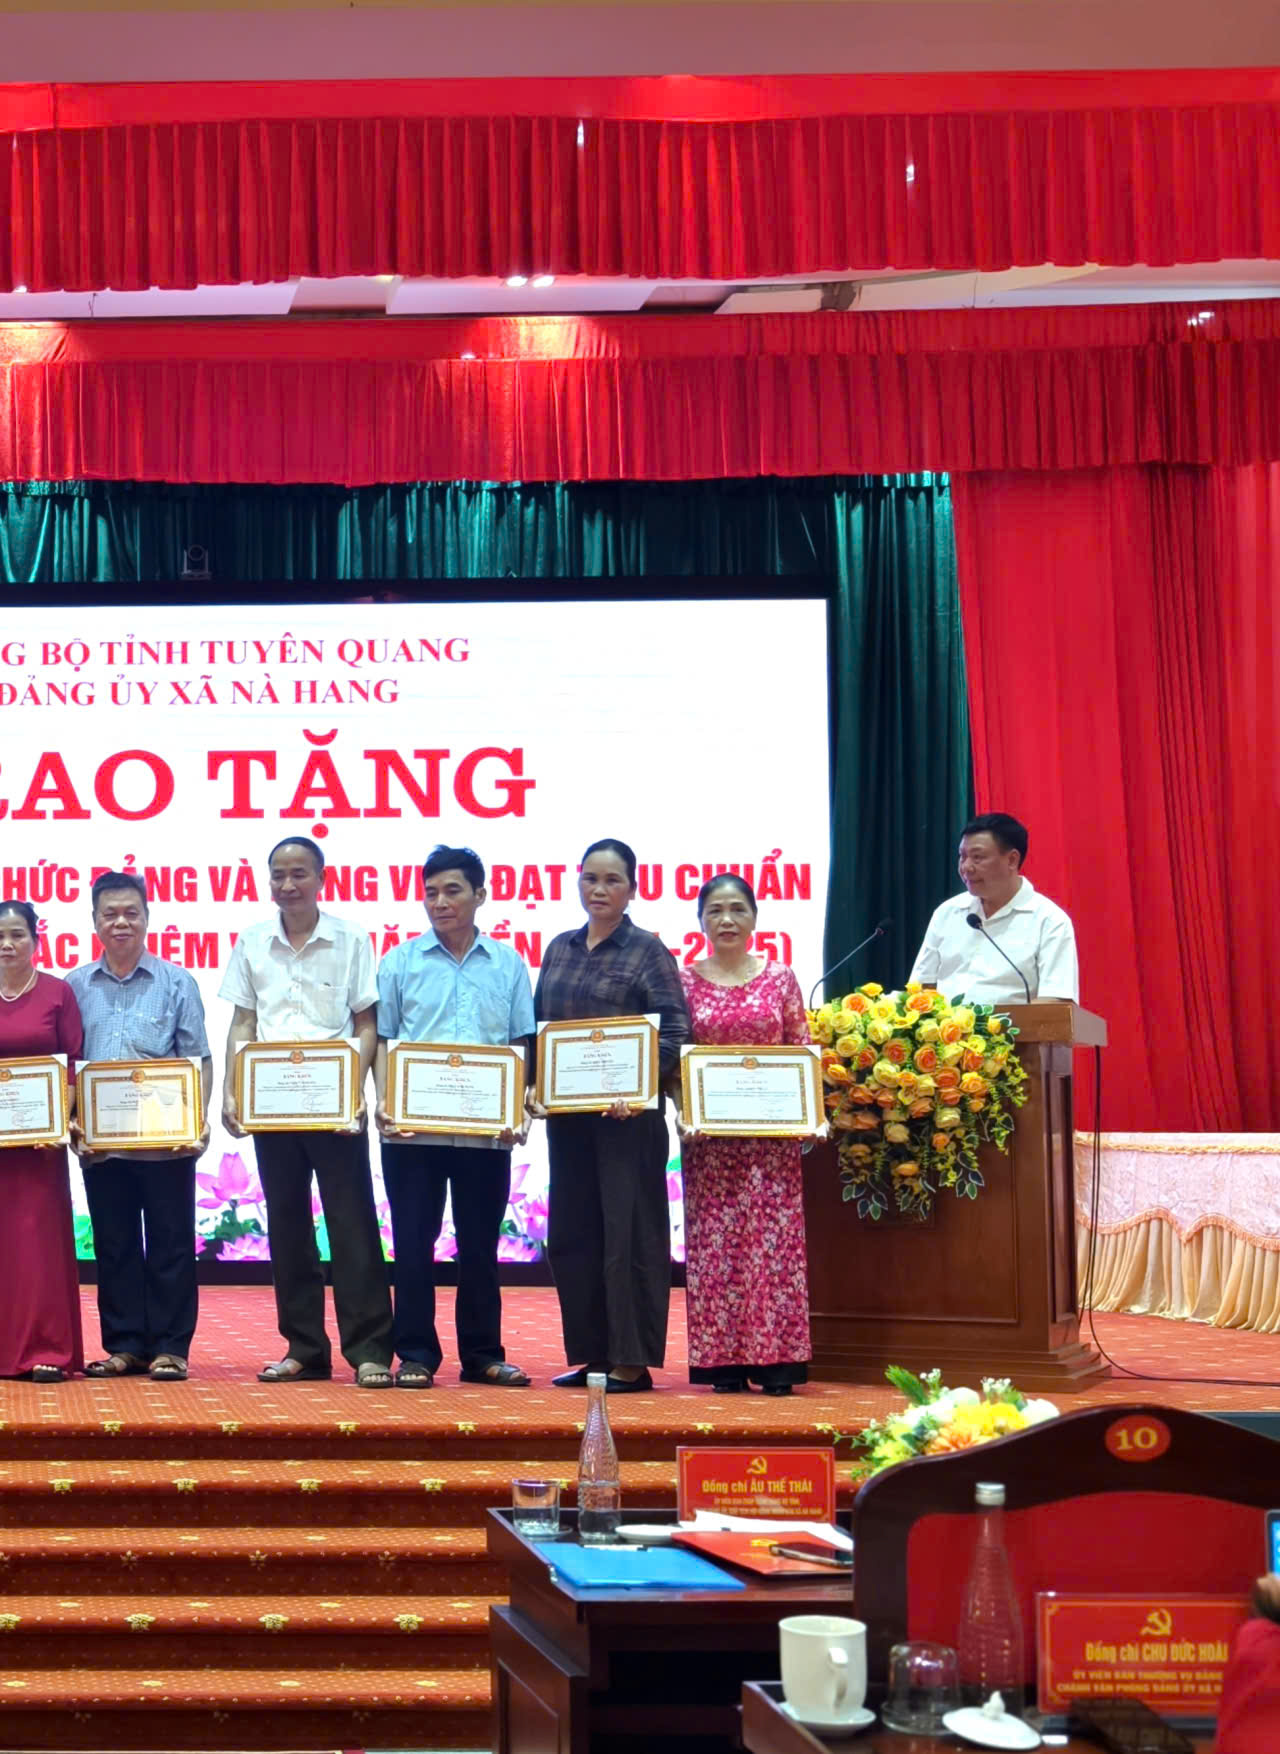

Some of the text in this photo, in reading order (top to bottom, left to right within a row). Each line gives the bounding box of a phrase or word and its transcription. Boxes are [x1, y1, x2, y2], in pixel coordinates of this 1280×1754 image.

[40, 638, 91, 672] BỘ
[99, 633, 191, 665] TỈNH
[200, 632, 324, 664] TUYÊN
[337, 638, 469, 668] QUANG
[110, 674, 159, 705] ỦY
[168, 674, 218, 704] XÃ
[231, 673, 281, 704] NÀ
[293, 679, 400, 704] HANG
[207, 728, 537, 839] TẶNG
[208, 858, 260, 902] VÀ
[490, 865, 567, 910] ĐẠT
[1115, 1426, 1158, 1450] 10
[1142, 1642, 1168, 1663] CHU
